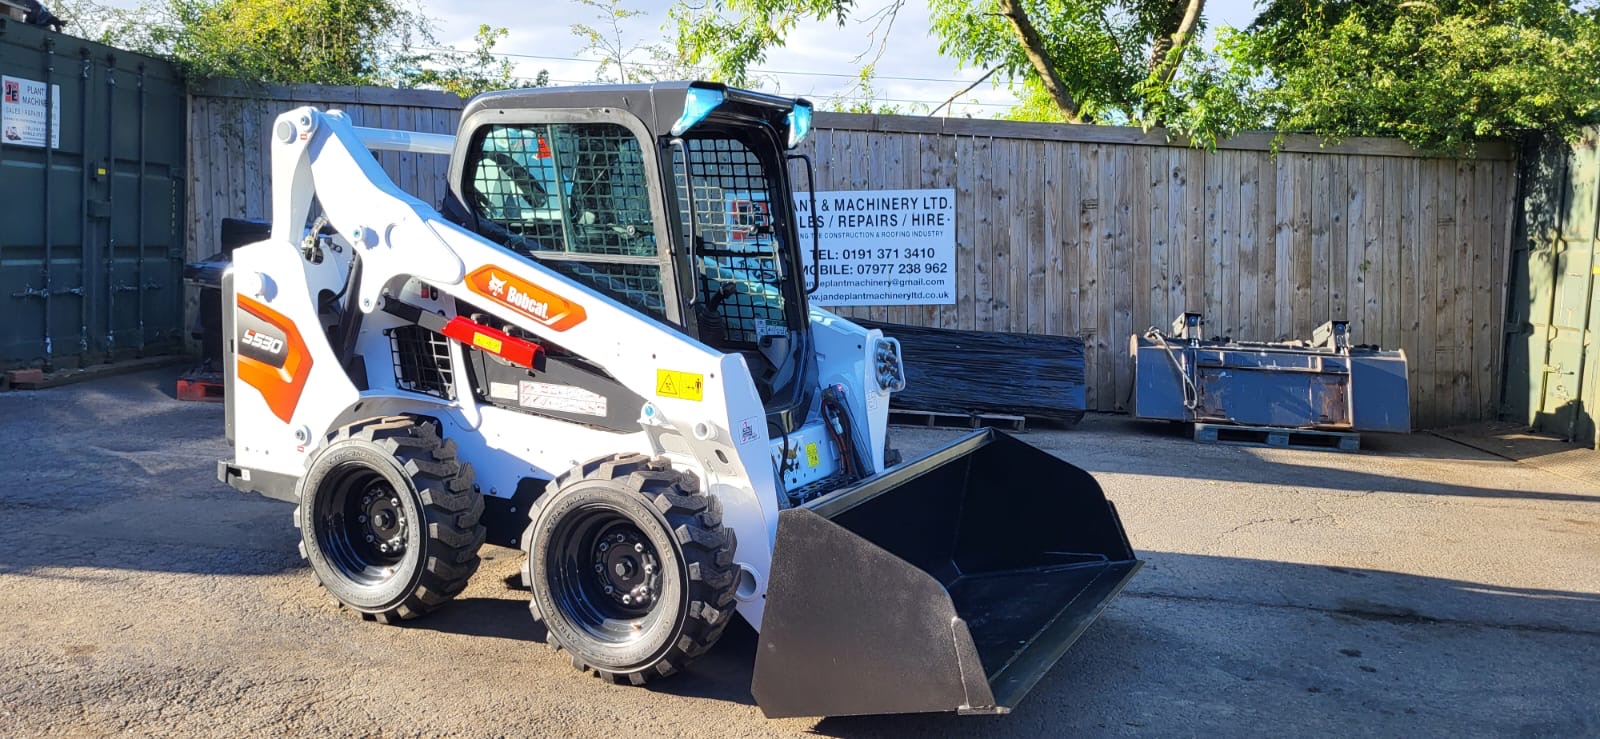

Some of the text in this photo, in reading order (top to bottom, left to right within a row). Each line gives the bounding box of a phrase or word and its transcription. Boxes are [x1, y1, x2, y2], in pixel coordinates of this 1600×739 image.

[821, 199, 830, 212] &
[834, 197, 919, 212] MACHINERY
[923, 197, 952, 210] LTD.
[799, 214, 825, 229] LES
[838, 213, 898, 228] REPAIRS
[911, 230, 943, 238] INDUSTRY
[809, 248, 935, 260] TEL: 0191 371 3410
[857, 263, 894, 275] 07977
[898, 263, 921, 274] 238
[924, 262, 948, 274] 962
[241, 329, 284, 354] S530
